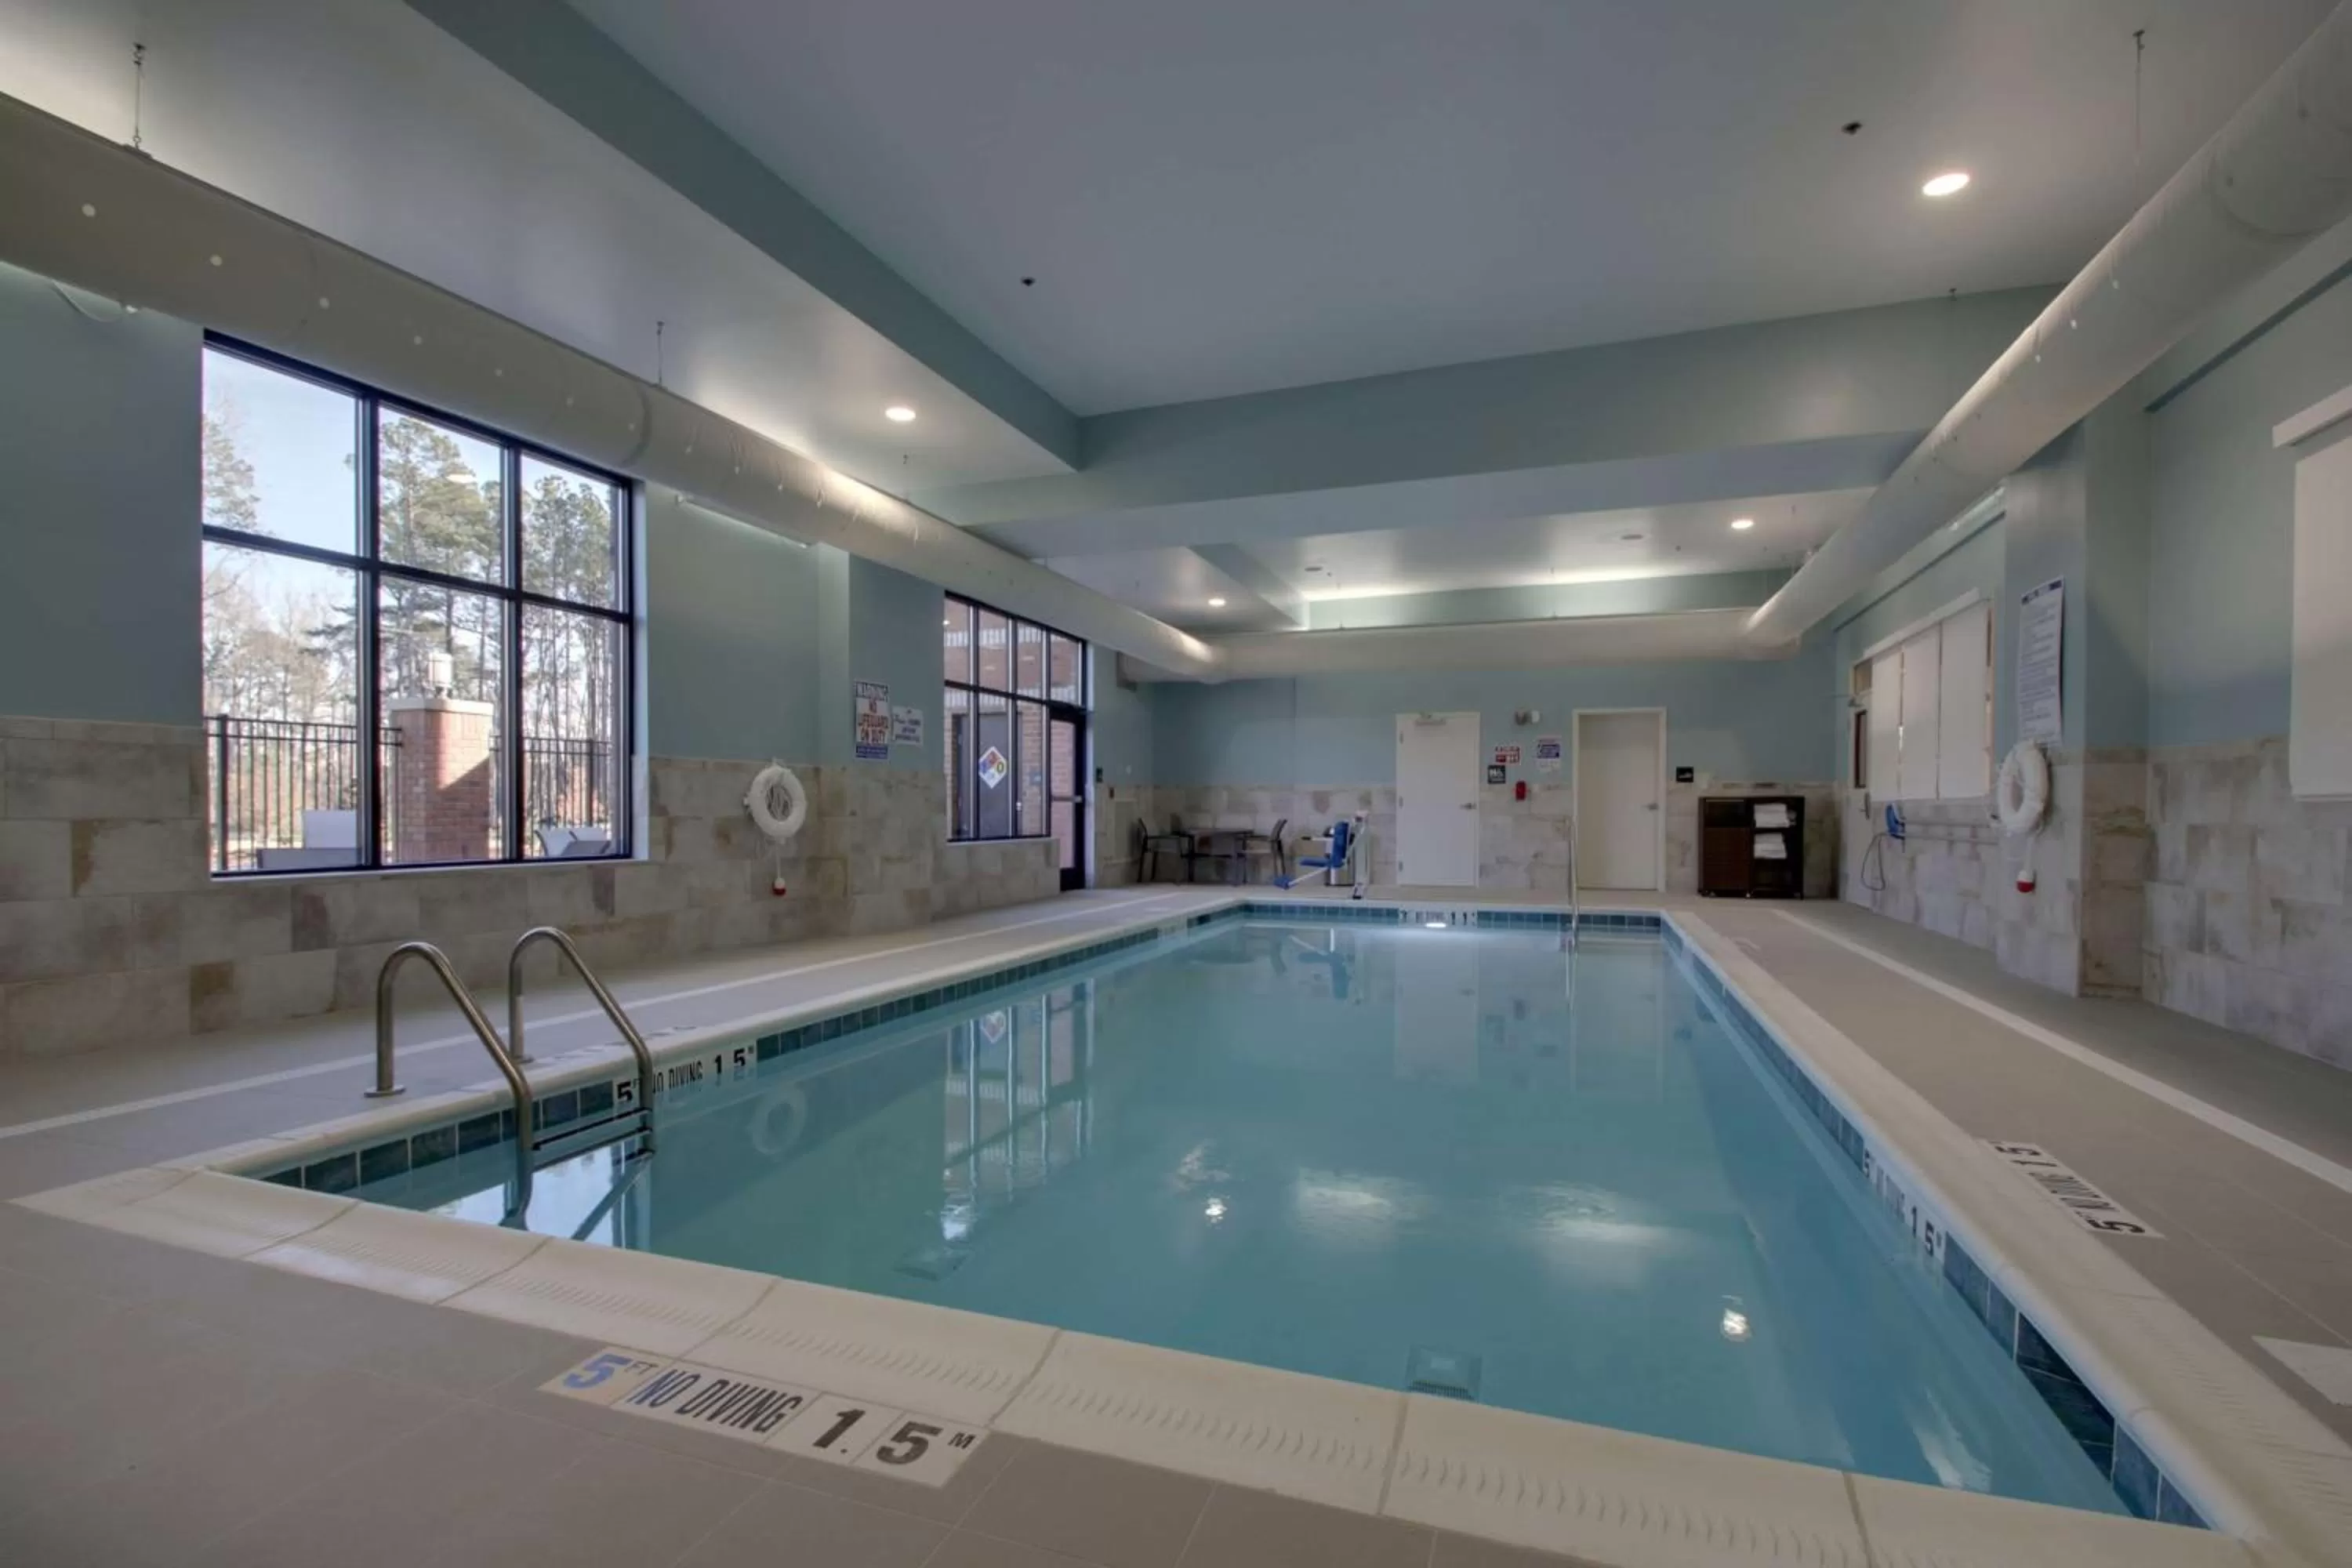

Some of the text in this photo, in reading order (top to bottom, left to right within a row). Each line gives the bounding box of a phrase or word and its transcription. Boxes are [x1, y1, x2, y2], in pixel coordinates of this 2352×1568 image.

[625, 1369, 701, 1408] NO
[674, 1378, 803, 1432] DIVING
[947, 1431, 976, 1450] M
